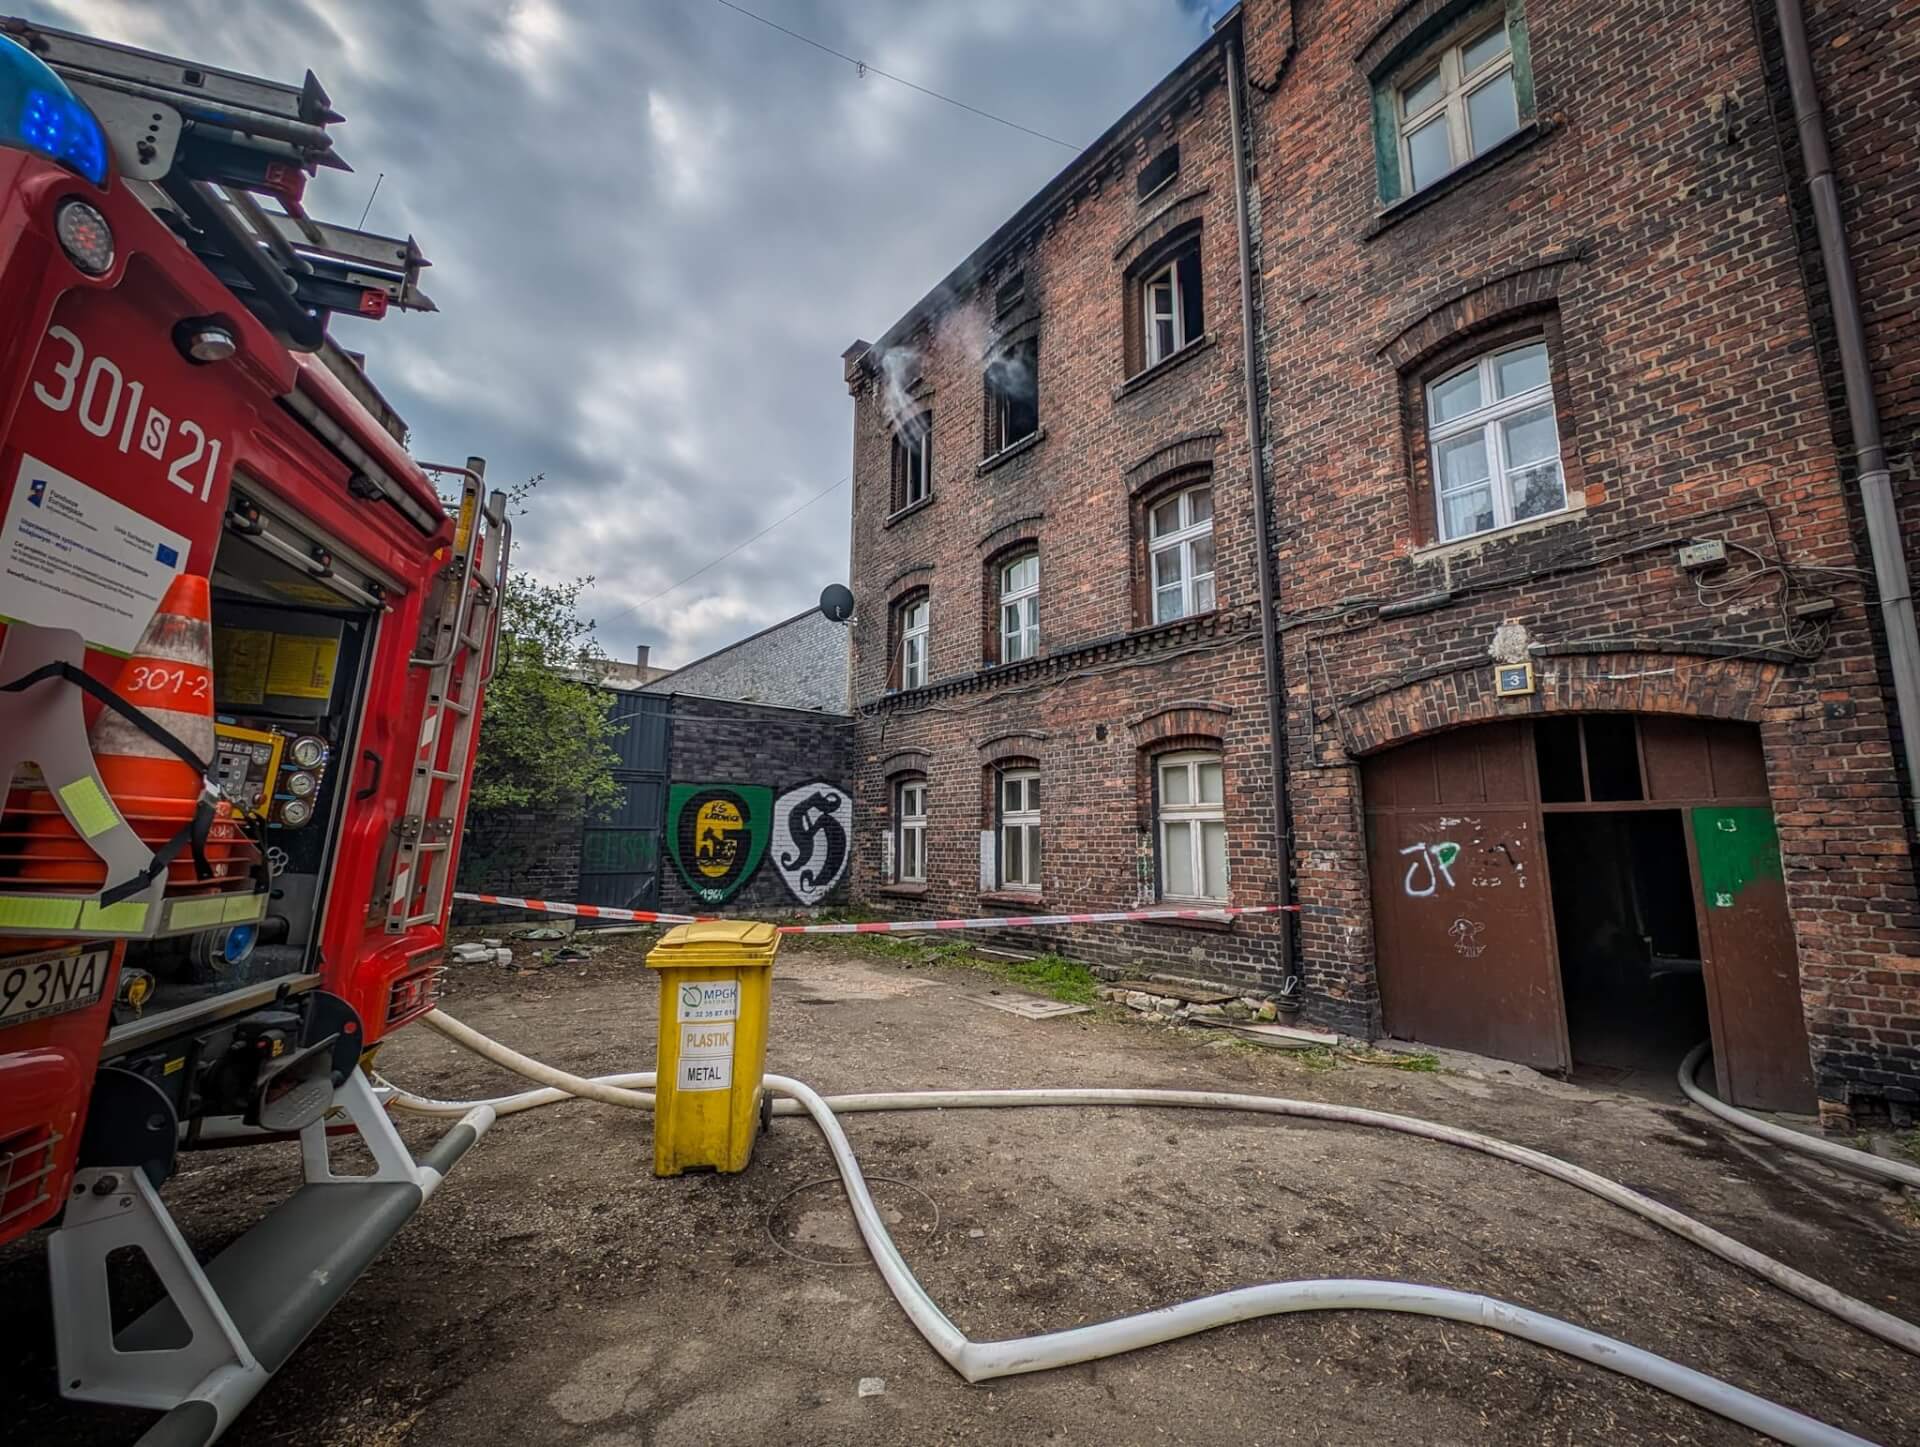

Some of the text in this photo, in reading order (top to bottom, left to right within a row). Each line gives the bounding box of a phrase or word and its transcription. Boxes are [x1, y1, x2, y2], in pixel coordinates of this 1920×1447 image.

[128, 666, 208, 698] 301-2
[1510, 675, 1520, 685] 3
[686, 1032, 729, 1048] PLASTIK
[687, 1066, 721, 1081] METAL
